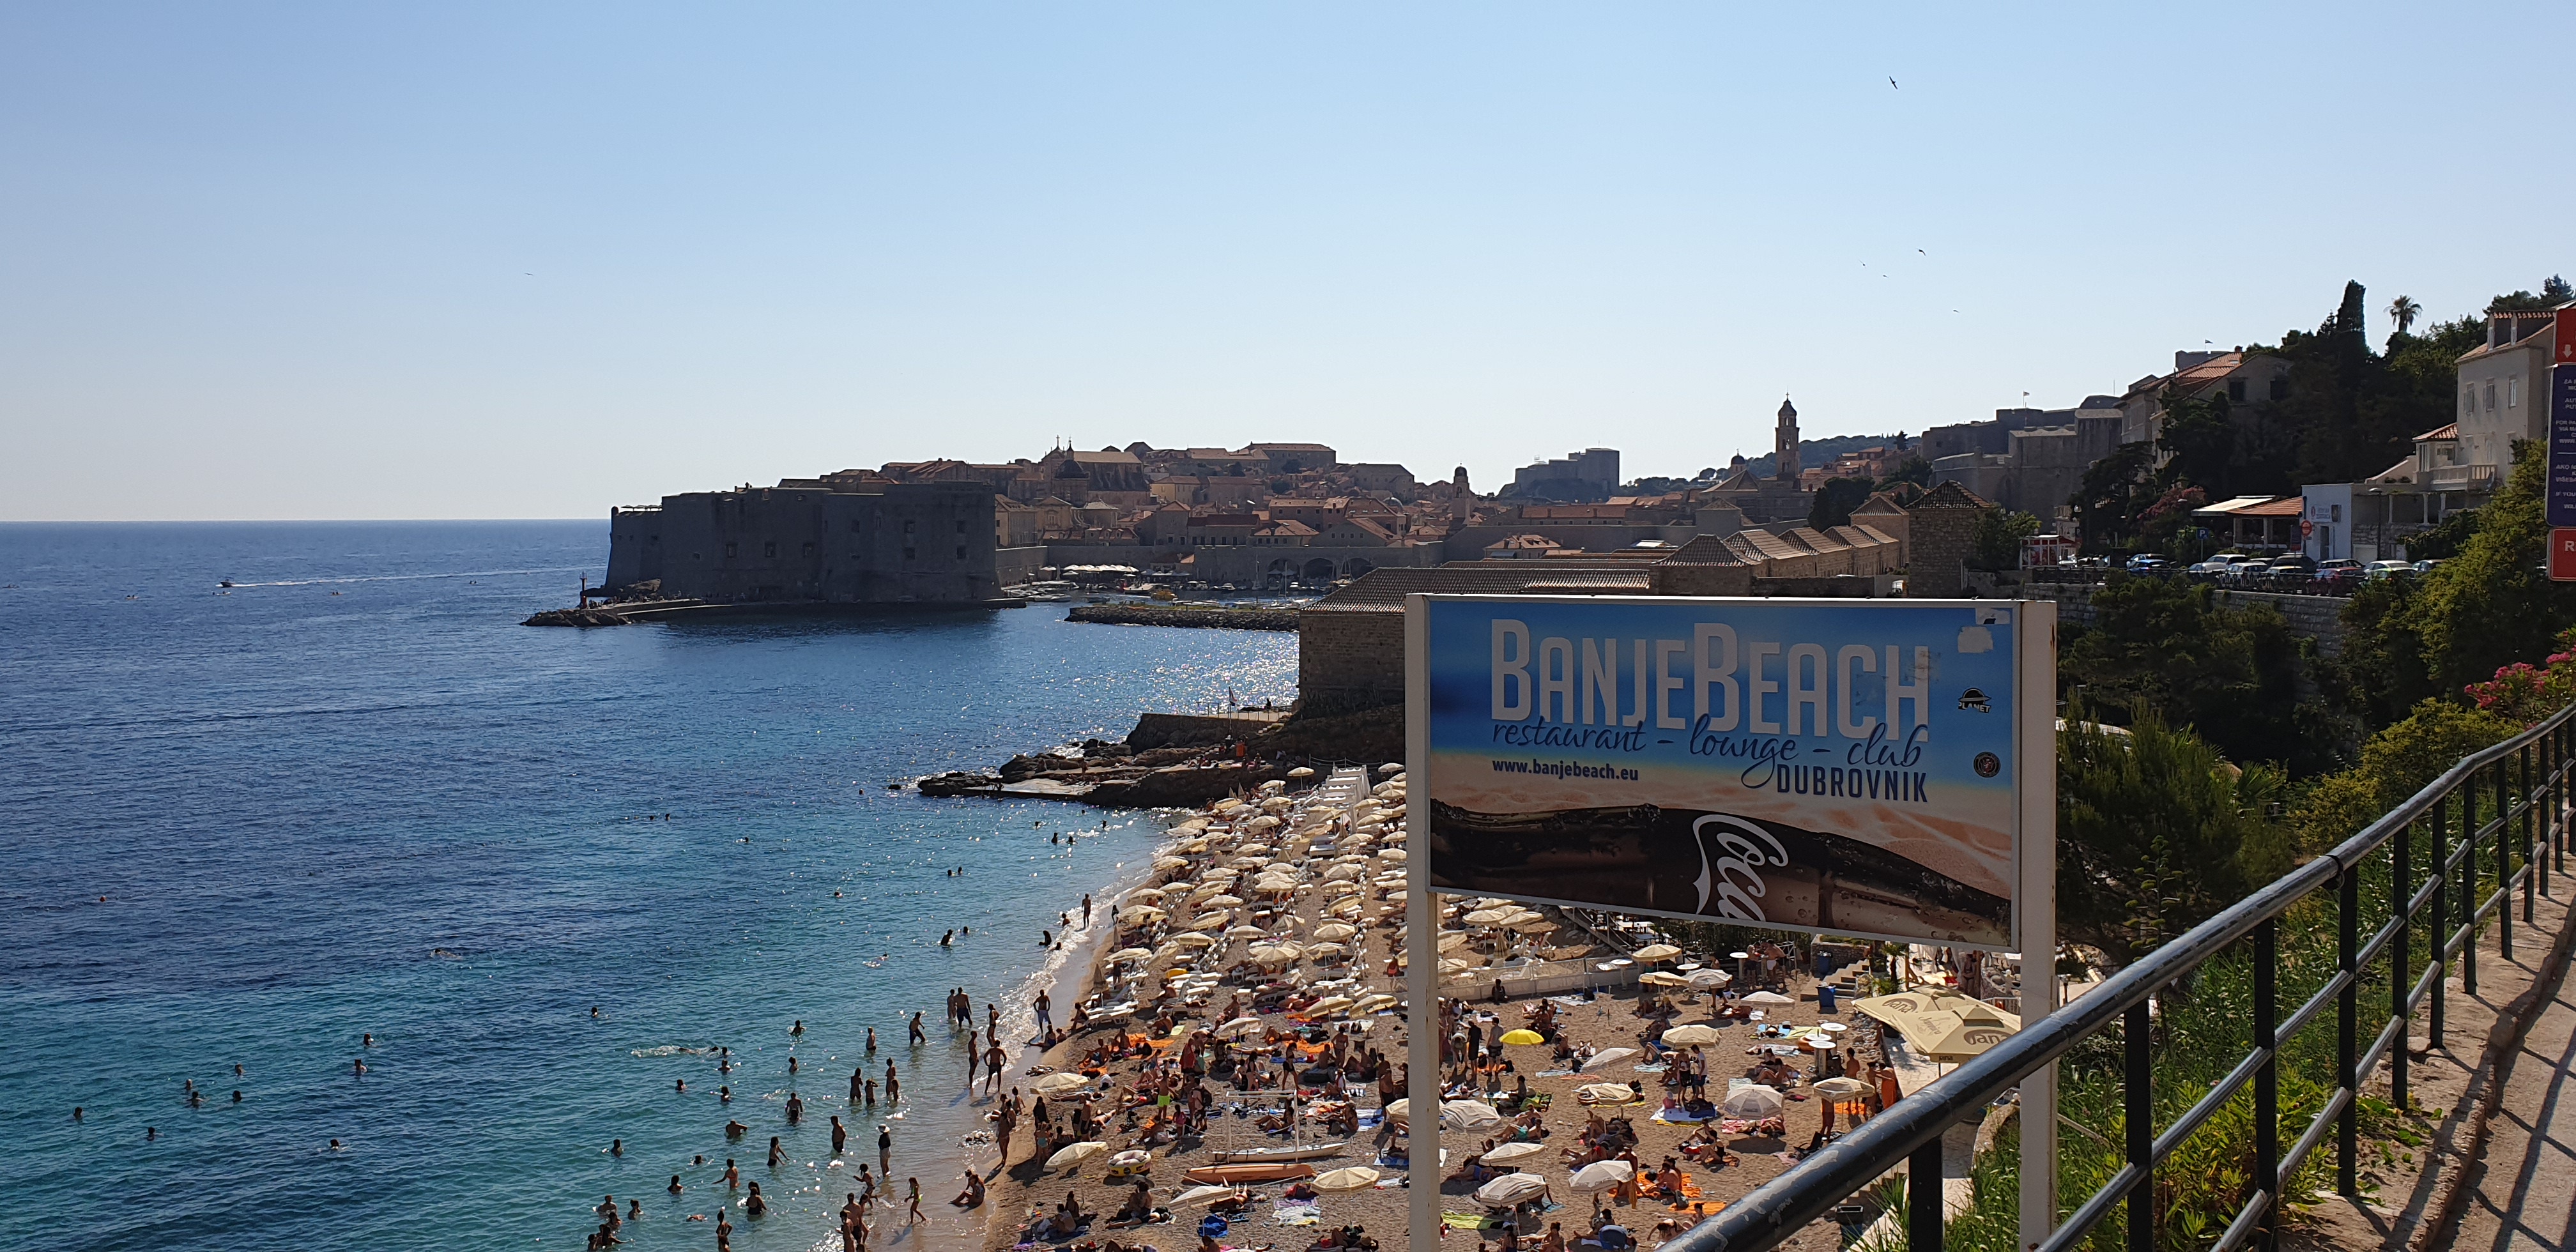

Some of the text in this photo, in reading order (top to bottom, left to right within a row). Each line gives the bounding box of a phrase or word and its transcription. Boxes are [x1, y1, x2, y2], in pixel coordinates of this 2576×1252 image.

[1958, 702, 1991, 713] PLANET
[1492, 715, 1647, 752] restaurant
[1689, 713, 1799, 789] lounge
[1846, 722, 1928, 767] club
[1492, 758, 1639, 781] www.banjebeach.eu
[1777, 763, 1928, 803] DUBROVNIK
